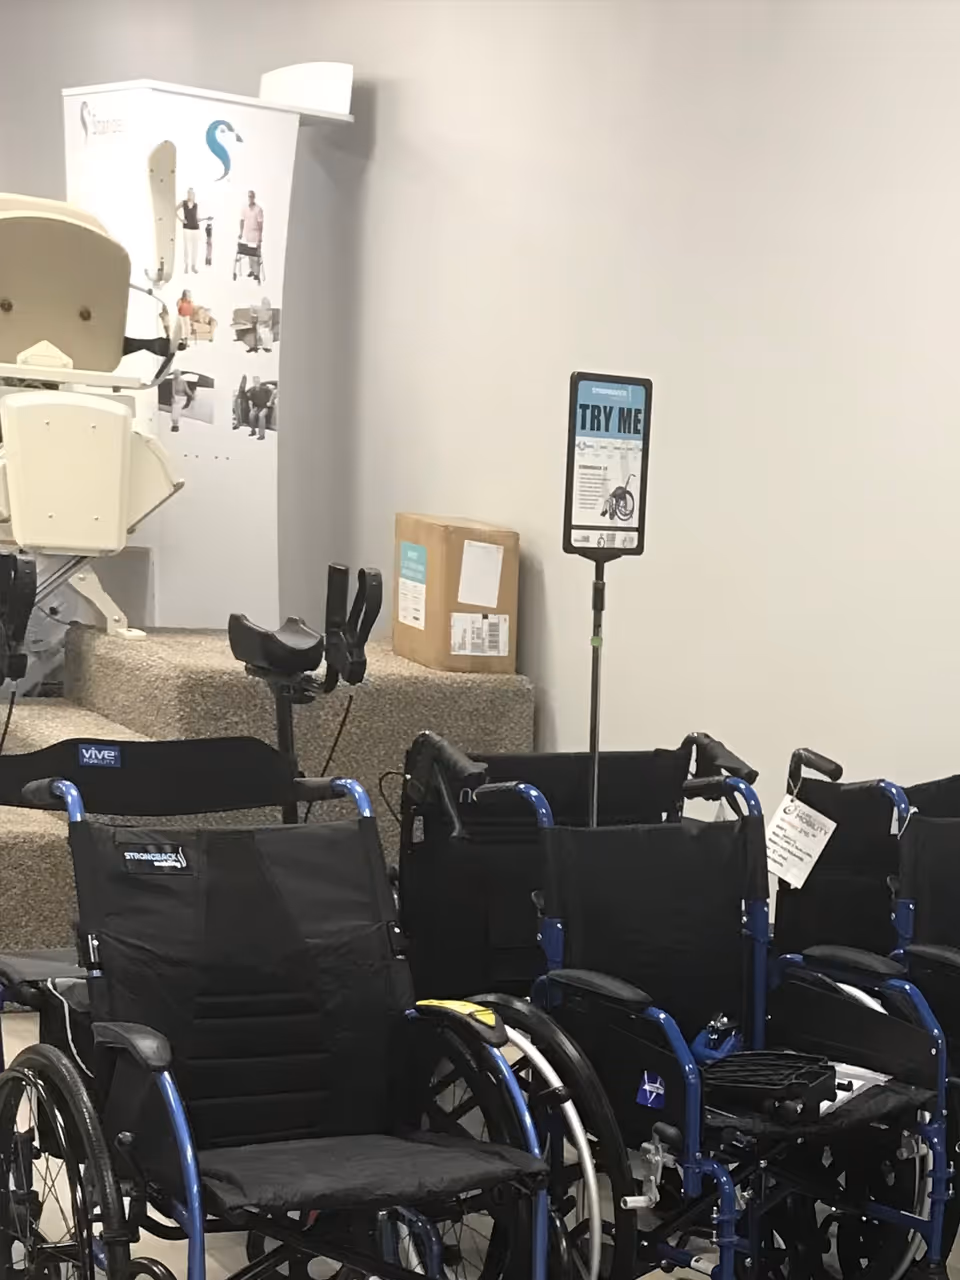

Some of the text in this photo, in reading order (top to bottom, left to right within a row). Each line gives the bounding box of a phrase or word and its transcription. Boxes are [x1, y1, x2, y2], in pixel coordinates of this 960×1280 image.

[579, 404, 642, 435] TRY ME
[82, 746, 115, 760] vive
[124, 852, 178, 861] STRONGBACK
